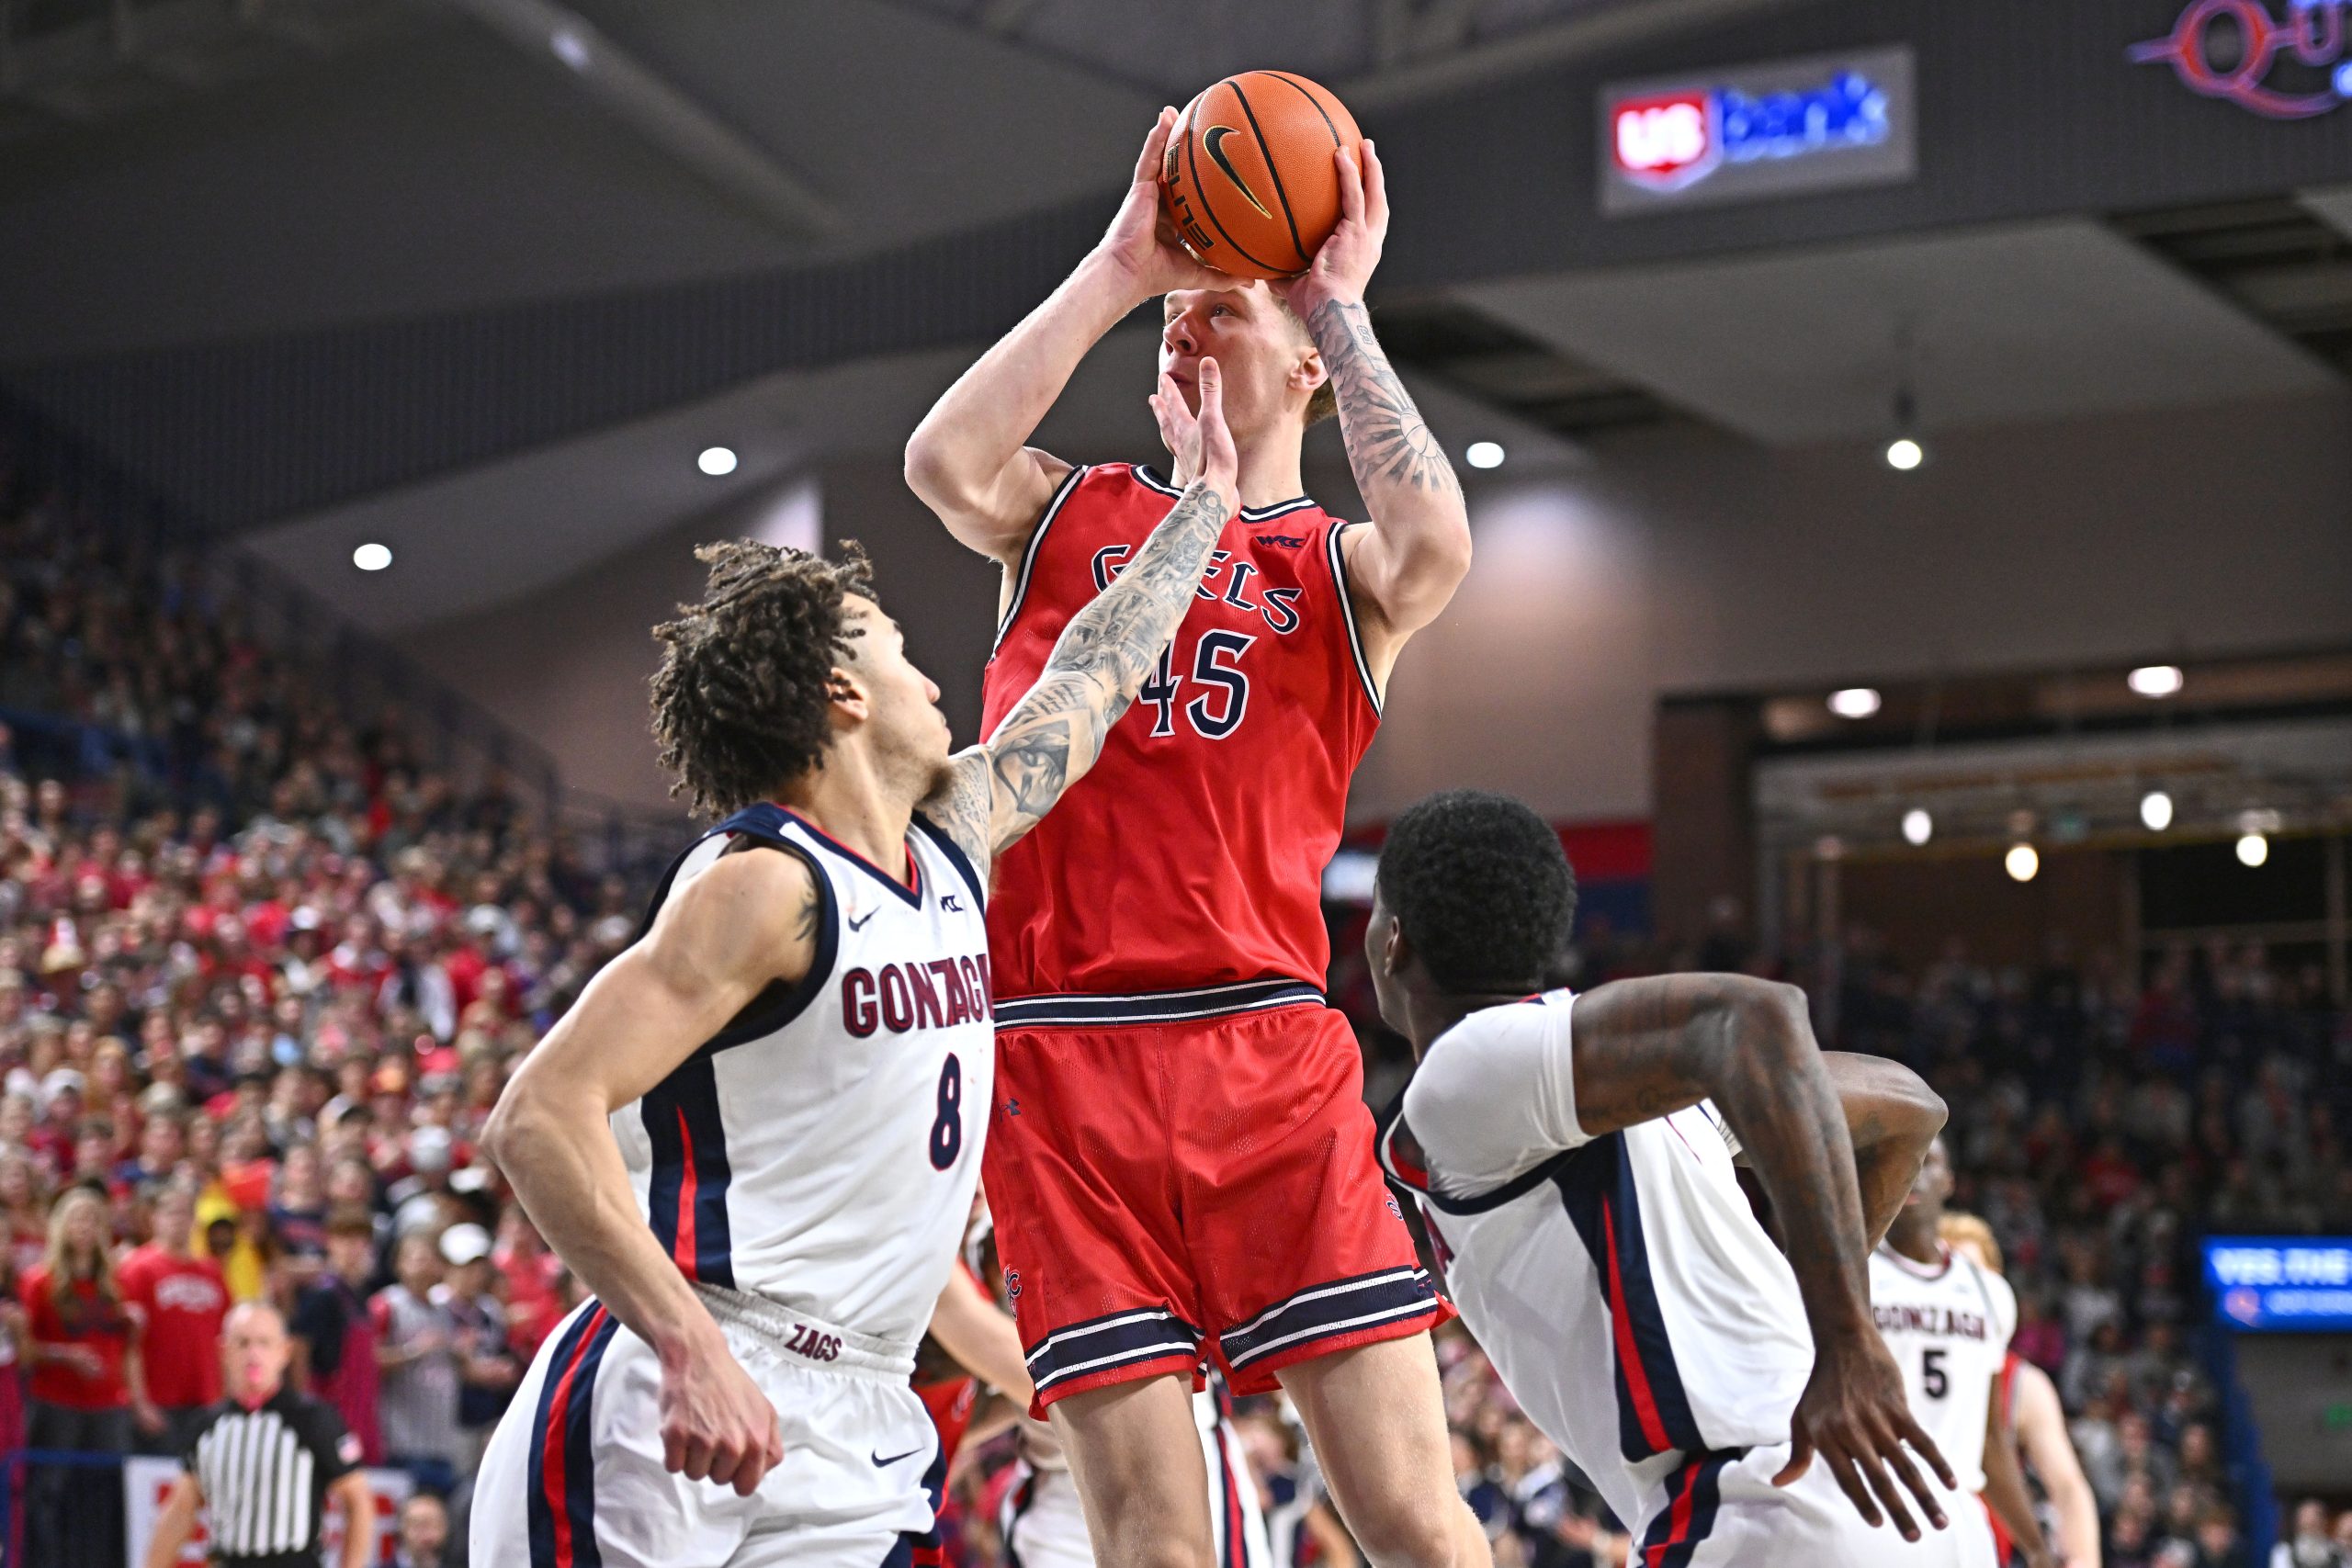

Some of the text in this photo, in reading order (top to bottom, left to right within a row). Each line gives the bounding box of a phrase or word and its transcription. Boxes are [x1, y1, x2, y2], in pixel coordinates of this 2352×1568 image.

[1166, 143, 1216, 251] ELITE
[1091, 544, 1303, 635] GELS
[1137, 628, 1258, 740] 45
[929, 1052, 962, 1172] 8
[784, 1323, 842, 1362] ZAGS
[1922, 1349, 1949, 1399] 5
